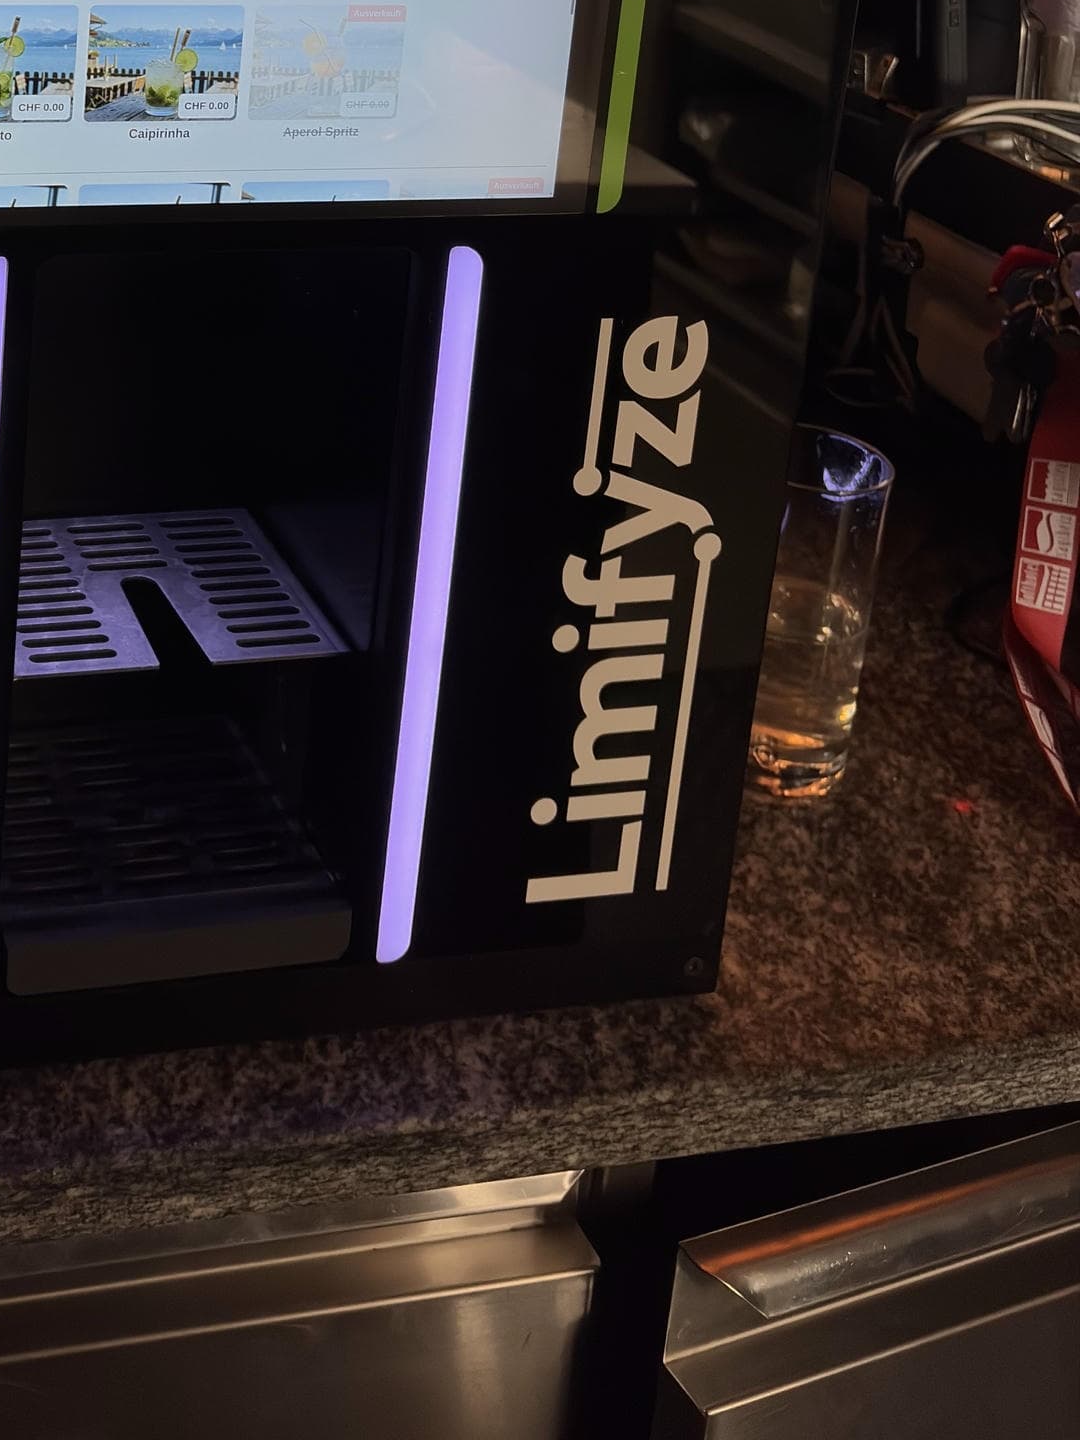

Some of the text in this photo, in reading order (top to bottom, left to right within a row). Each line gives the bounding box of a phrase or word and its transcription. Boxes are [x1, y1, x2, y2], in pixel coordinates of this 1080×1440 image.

[18, 102, 64, 113] CHF 0.00
[184, 100, 229, 111] CHF 0.00
[128, 127, 191, 142] Caipirinha
[283, 126, 359, 139] Aperol Spritz
[525, 315, 715, 903] Limifyze
